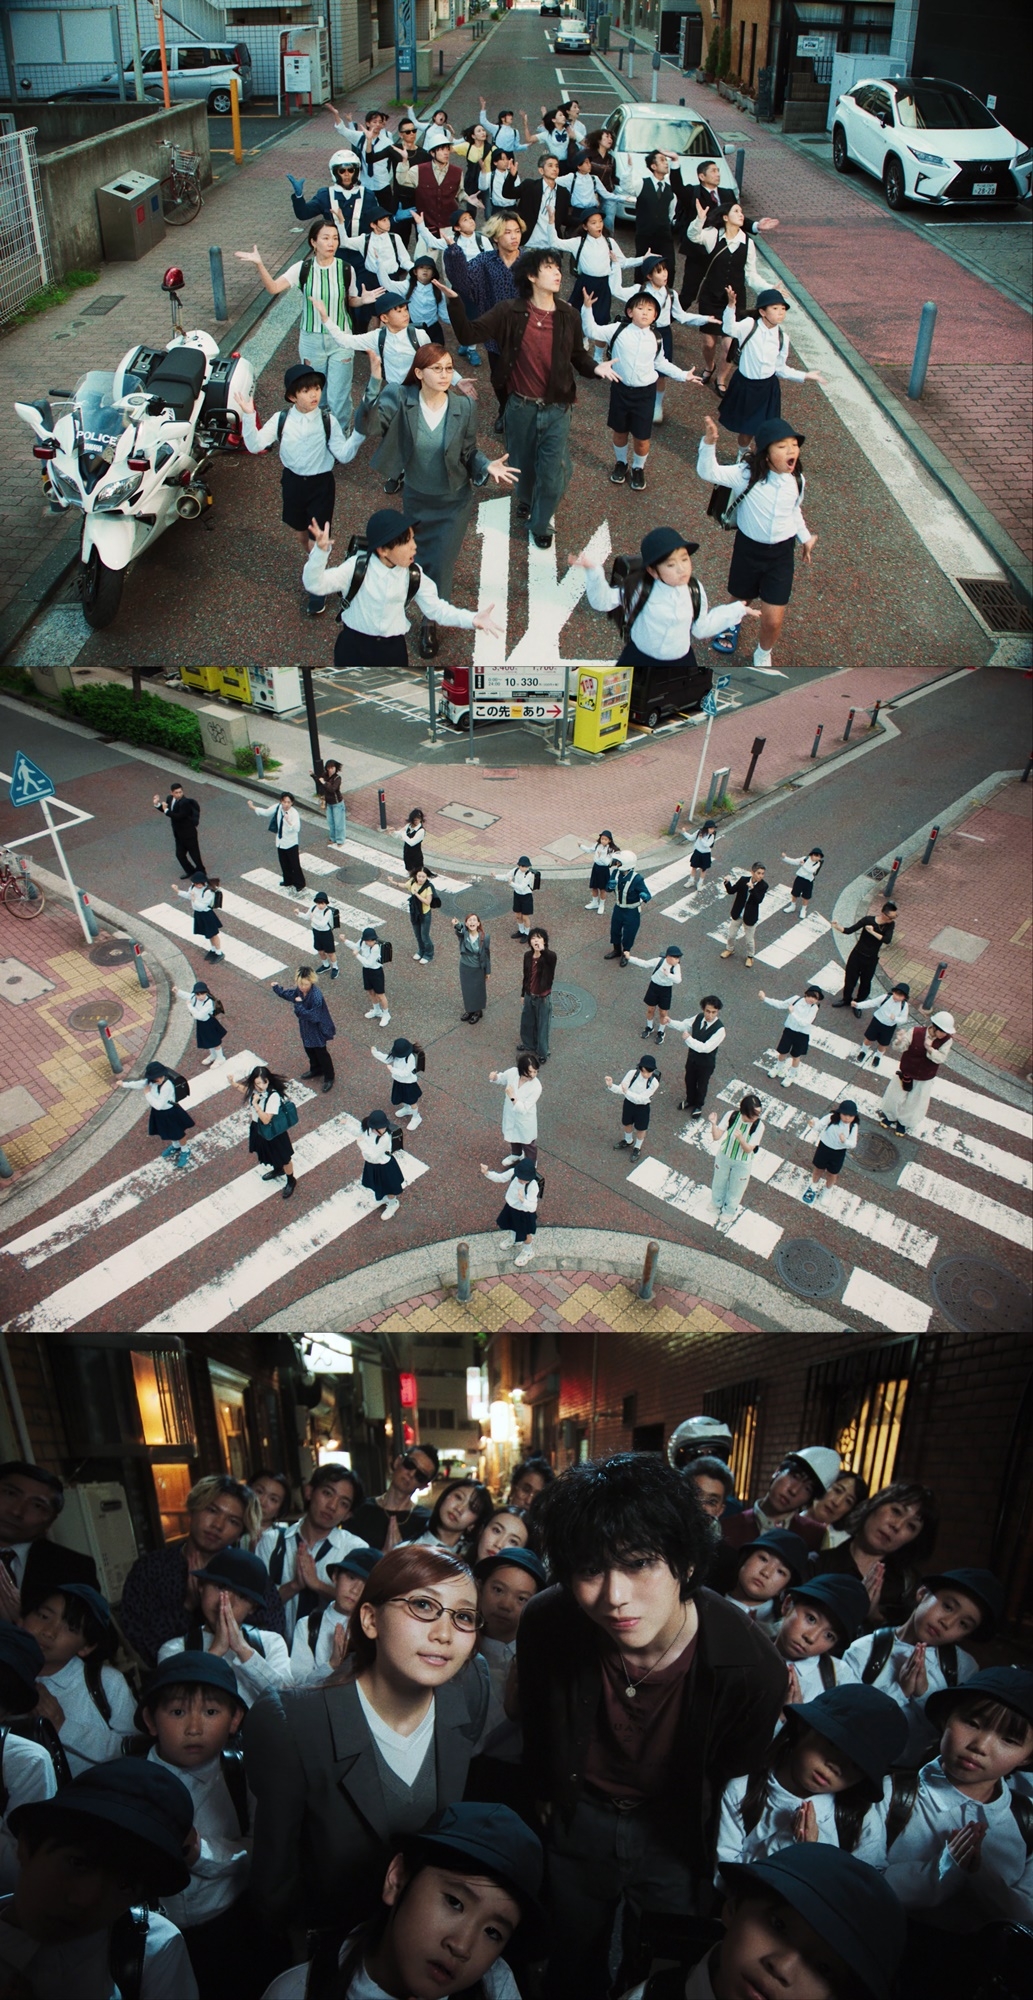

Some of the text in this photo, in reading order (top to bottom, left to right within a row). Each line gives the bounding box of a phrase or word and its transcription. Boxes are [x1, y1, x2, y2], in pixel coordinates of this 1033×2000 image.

[76, 431, 117, 446] POLICE
[476, 706, 510, 718] この先
[523, 706, 545, 718] あり
